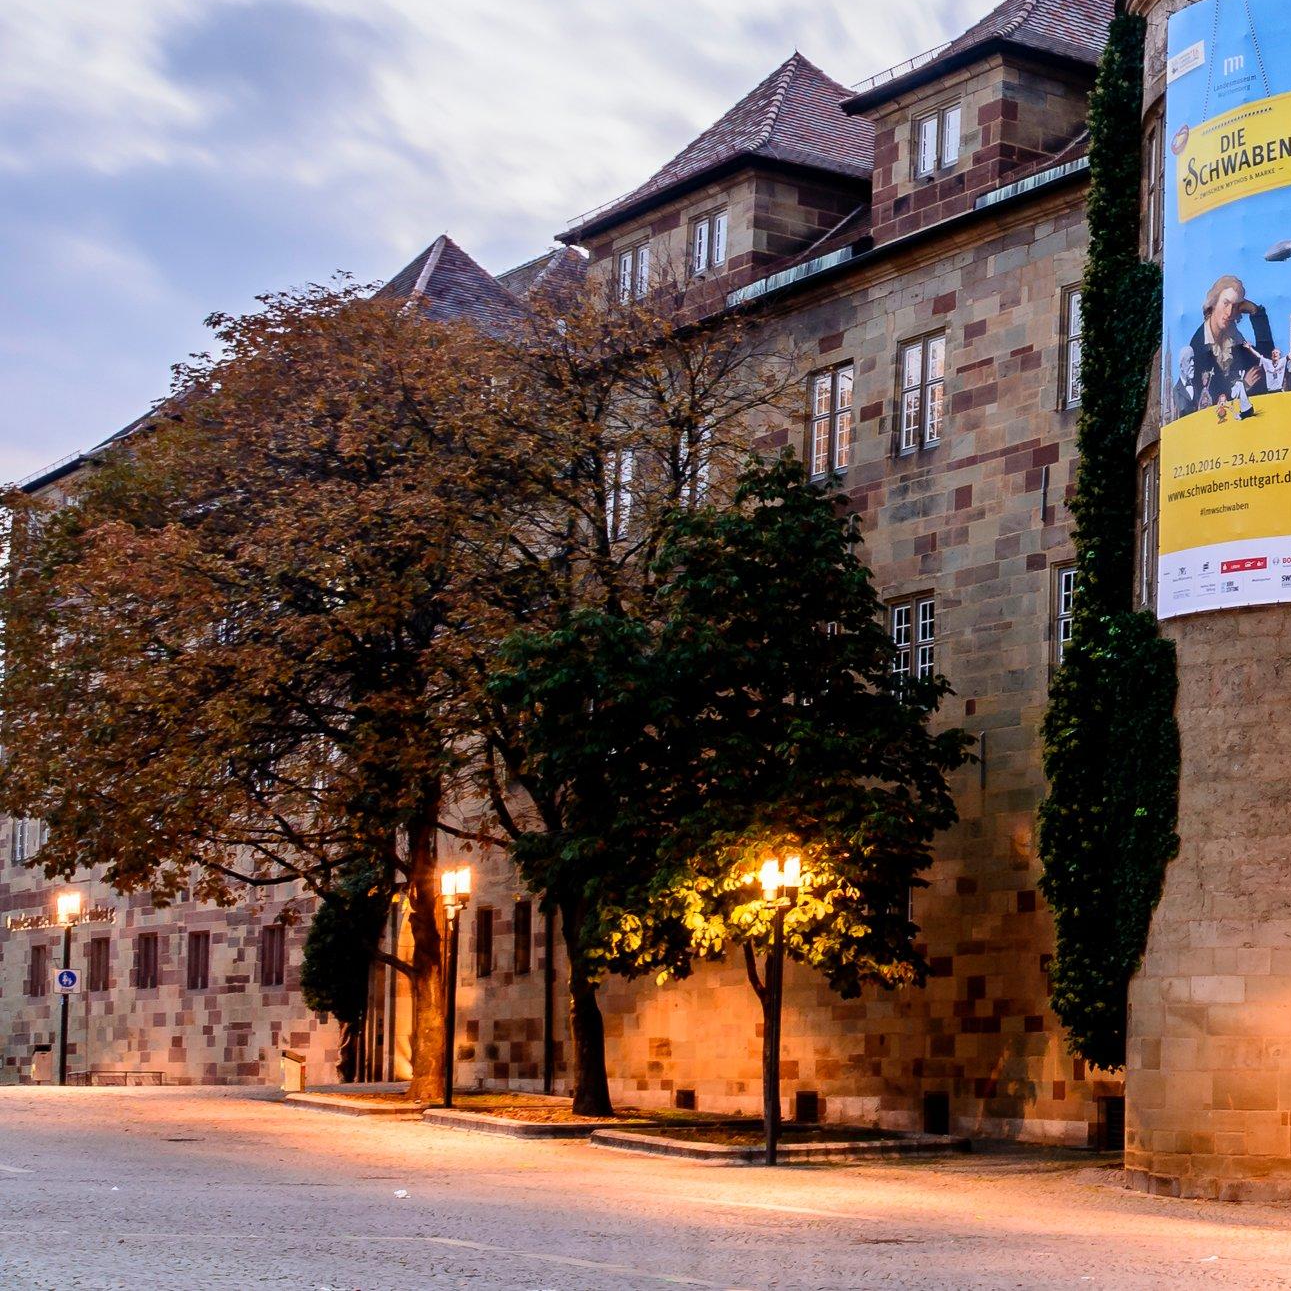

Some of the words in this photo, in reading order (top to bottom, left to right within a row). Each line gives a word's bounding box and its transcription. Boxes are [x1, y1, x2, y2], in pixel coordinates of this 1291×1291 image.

[1220, 127, 1246, 153] DIE
[1200, 183, 1224, 199] ZWISCHEN
[1225, 176, 1248, 188] MYTHOS
[1254, 167, 1276, 178] MARKE
[1173, 457, 1221, 479] 22.10.2016
[1231, 448, 1290, 467] 23.4.2017
